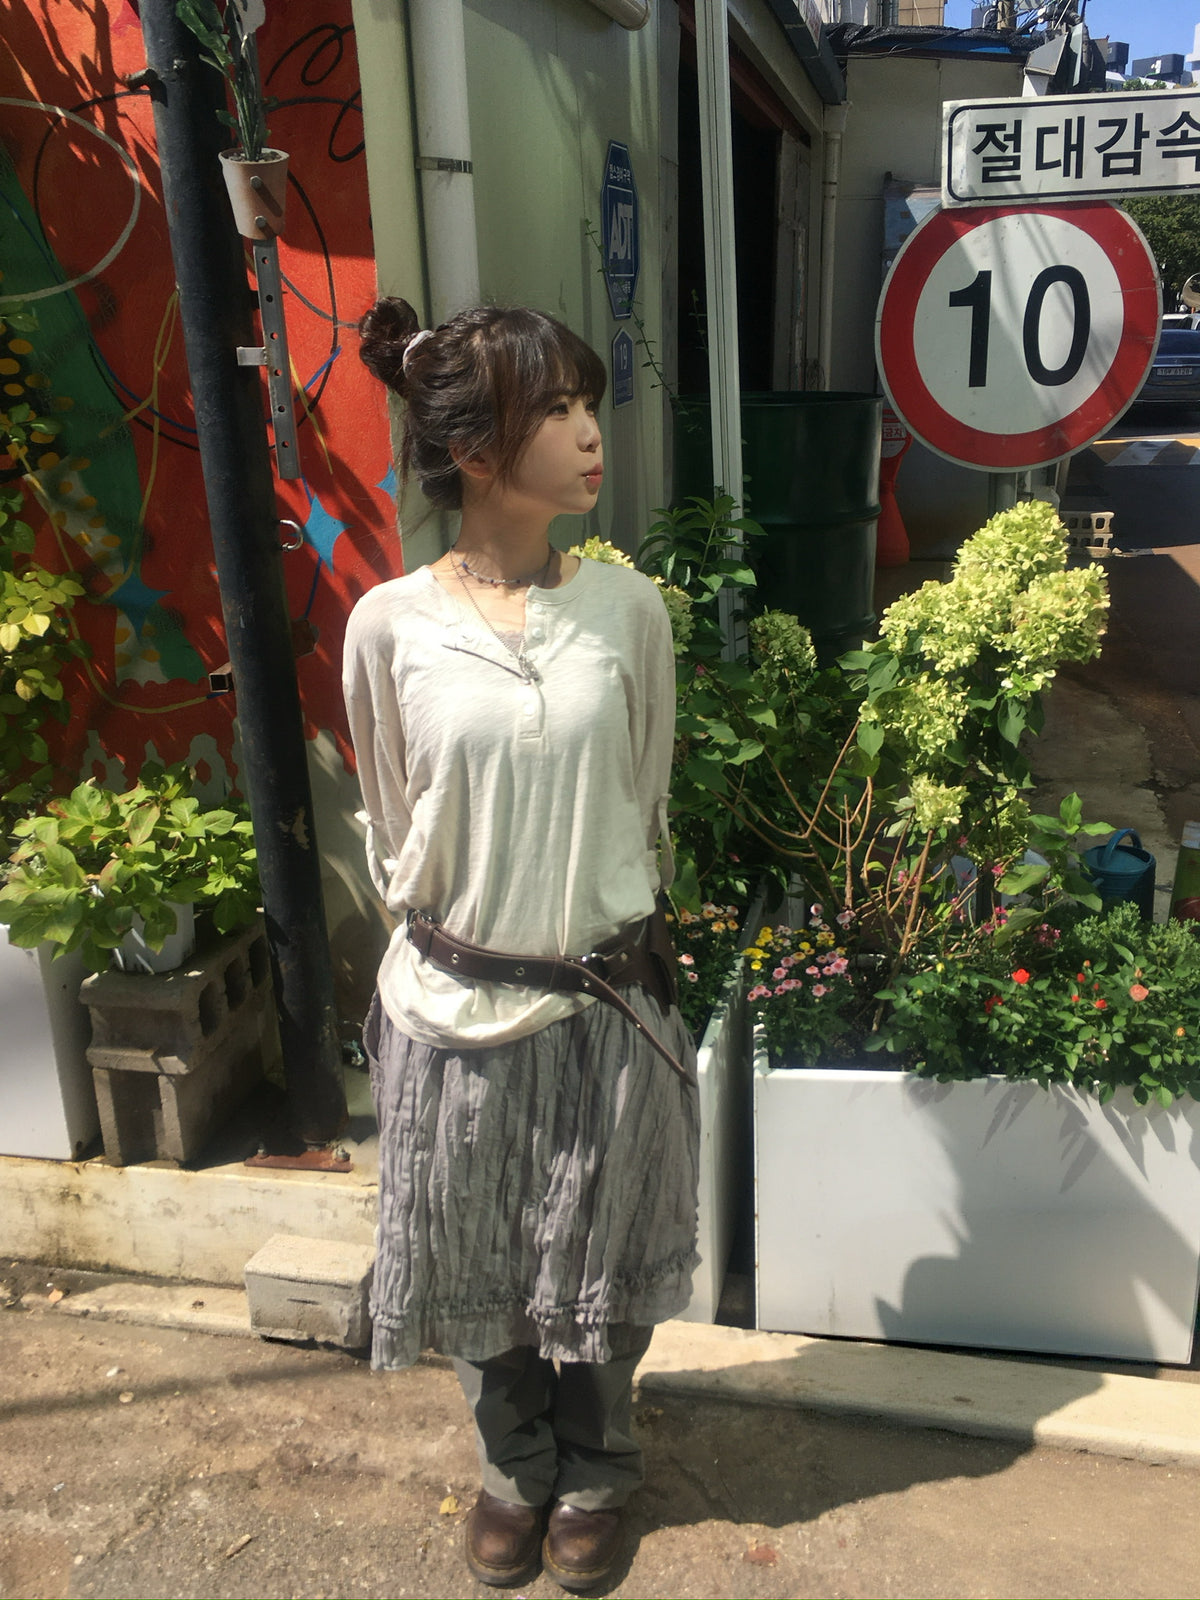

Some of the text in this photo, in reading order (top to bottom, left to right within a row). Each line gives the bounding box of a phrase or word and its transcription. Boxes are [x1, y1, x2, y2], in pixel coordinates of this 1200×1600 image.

[972, 111, 1200, 183] 절대감속
[609, 202, 633, 259] ADT
[619, 343, 628, 370] 19
[949, 264, 1091, 388] 10
